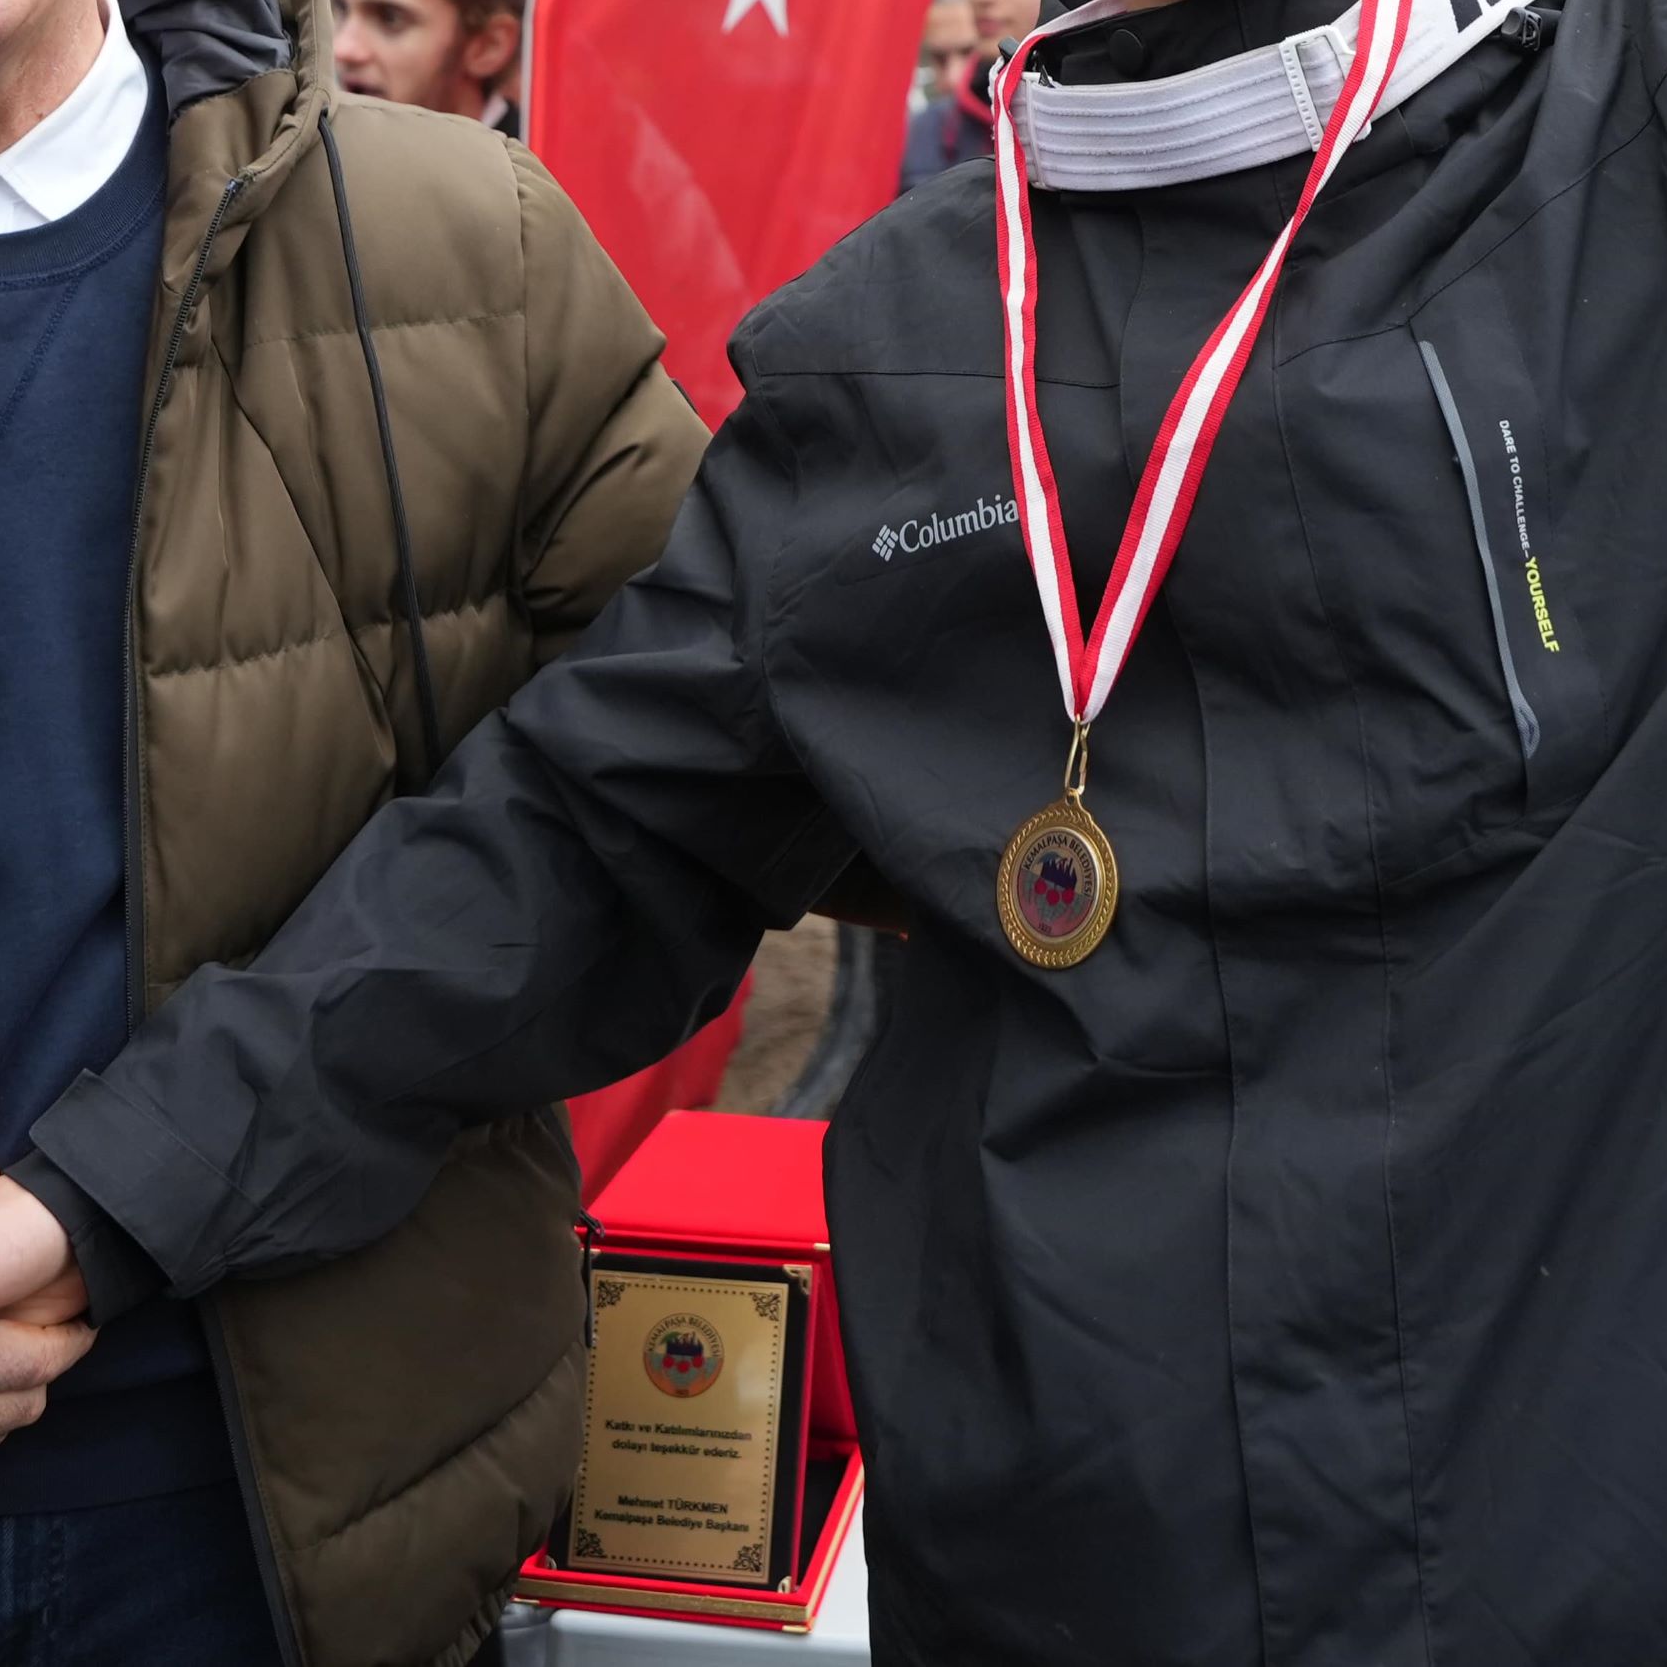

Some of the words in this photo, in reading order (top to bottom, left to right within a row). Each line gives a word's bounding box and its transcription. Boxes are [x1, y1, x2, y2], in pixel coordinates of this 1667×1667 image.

[899, 494, 1019, 553] Columbia
[1499, 419, 1517, 454] DARE
[1509, 457, 1521, 474] TO
[1525, 556, 1559, 653] YOURSELF
[1023, 834, 1068, 870] KEMALPAŞA
[1069, 836, 1094, 897] BELEDİYESİ
[647, 1316, 687, 1353] KEMALPAŞA
[638, 1423, 652, 1433] ve
[612, 1438, 647, 1453] dolayı
[650, 1441, 700, 1456] teşekkür
[617, 1494, 665, 1510] Mehmet
[667, 1496, 729, 1515] TÜRKMEN
[594, 1508, 654, 1526] Kemalpaşa
[656, 1514, 704, 1531] Belediye
[705, 1518, 749, 1533] Başkanı
